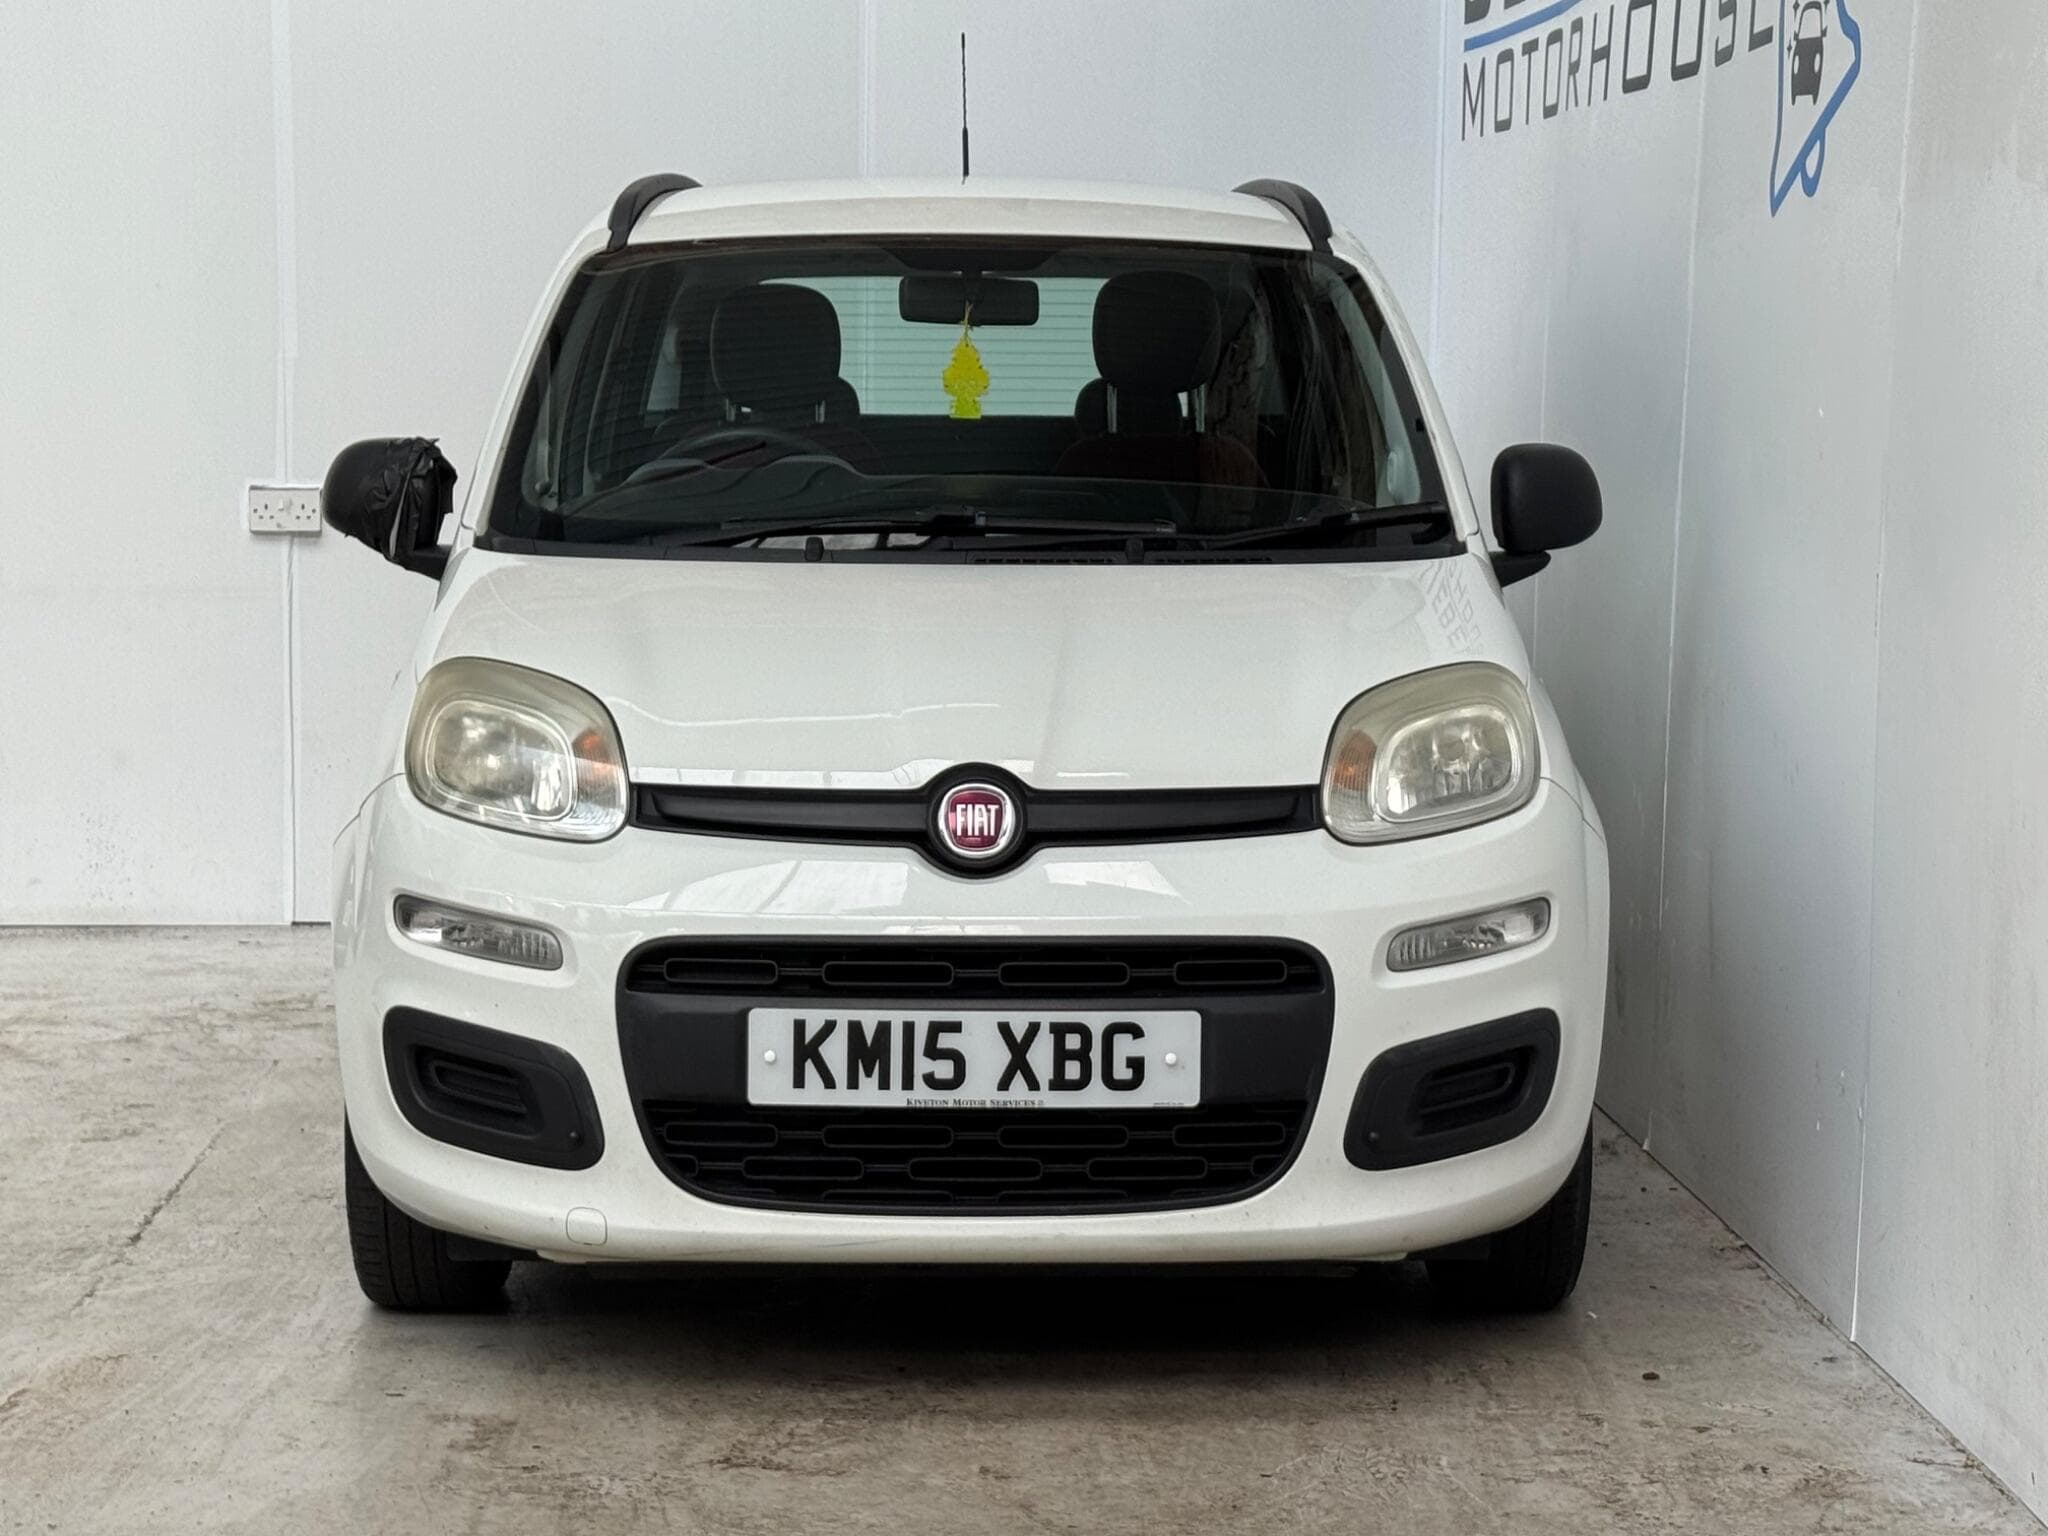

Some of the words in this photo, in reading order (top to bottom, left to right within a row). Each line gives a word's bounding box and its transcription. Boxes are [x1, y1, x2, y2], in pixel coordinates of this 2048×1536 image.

[956, 803, 999, 836] FIAT
[792, 1018, 967, 1091] KM15
[996, 1021, 1146, 1092] XBG
[953, 1098, 986, 1106] MOTOR
[990, 1098, 1036, 1106] SERVICES
